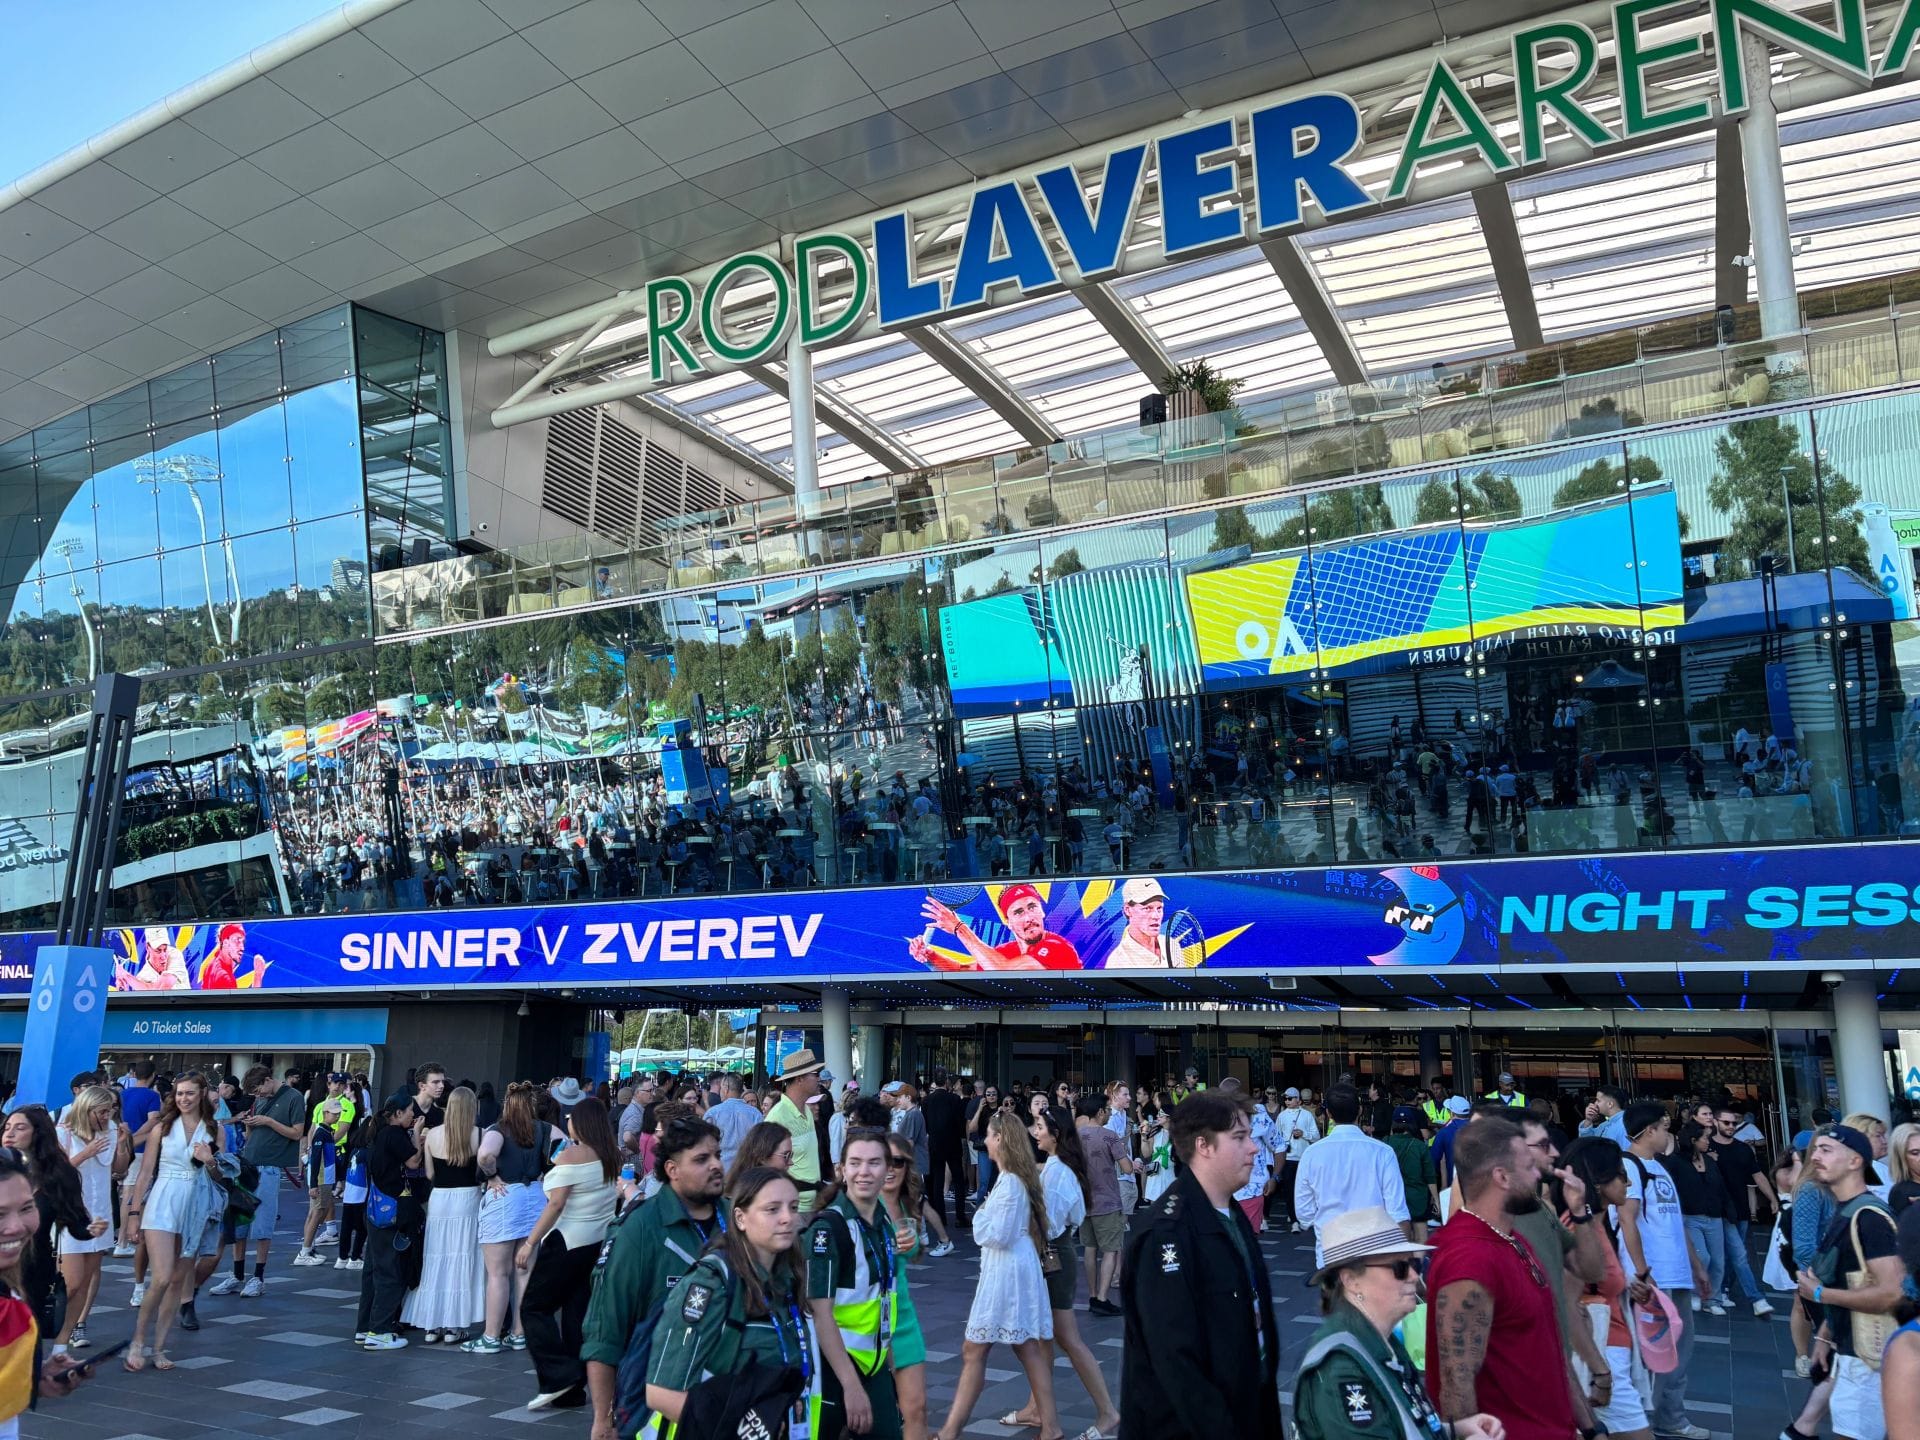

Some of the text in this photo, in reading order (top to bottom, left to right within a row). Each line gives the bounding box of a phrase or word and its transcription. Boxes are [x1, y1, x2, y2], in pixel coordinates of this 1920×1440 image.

[646, 232, 870, 381] ROD
[874, 94, 1372, 325] LAVER
[1500, 889, 1727, 935] NIGHT
[1743, 881, 1920, 930] SES
[339, 912, 824, 974] SINNER V ZVEREV
[0, 964, 34, 979] INAL
[132, 1020, 212, 1035] AO Ticket Sales
